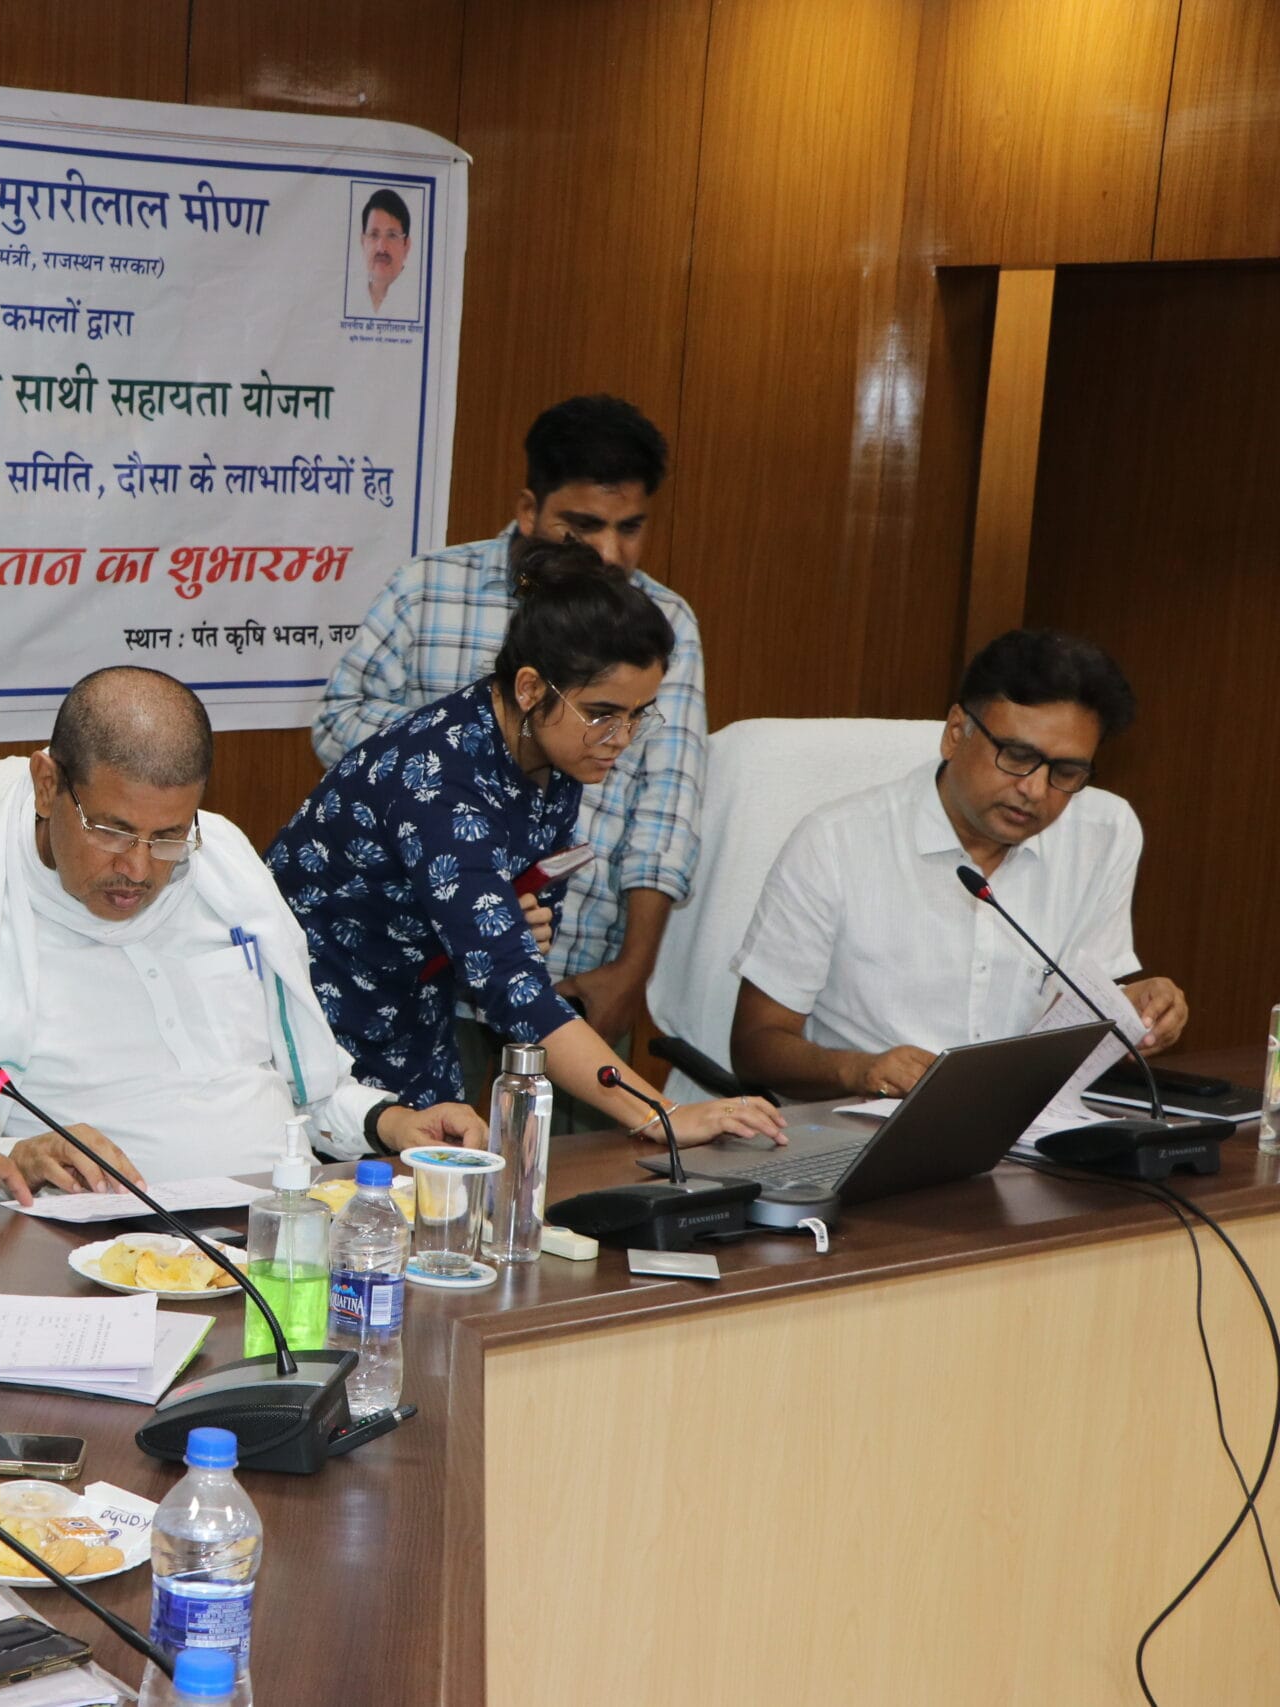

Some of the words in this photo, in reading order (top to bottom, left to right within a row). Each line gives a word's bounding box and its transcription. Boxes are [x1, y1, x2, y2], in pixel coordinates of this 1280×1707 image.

[179, 180, 270, 235] मीणा
[43, 252, 105, 271] राजस्थन
[109, 257, 164, 278] सरकार)
[0, 297, 81, 333] कमलों
[86, 309, 135, 340] द्वारा
[12, 363, 99, 413] साथी
[108, 379, 232, 421] सहायता
[241, 369, 335, 419] योजना
[5, 451, 104, 499] समिति,
[113, 451, 182, 498] दौसा
[189, 453, 216, 493] के
[223, 454, 355, 494] लाभार्थियों
[361, 456, 394, 508] हेतु
[96, 547, 160, 583] का
[168, 546, 353, 599] शुभारम्भ
[123, 629, 172, 650] स्थान
[191, 621, 219, 647] पंत
[224, 619, 266, 654] कृषि
[273, 626, 323, 648] भवन,
